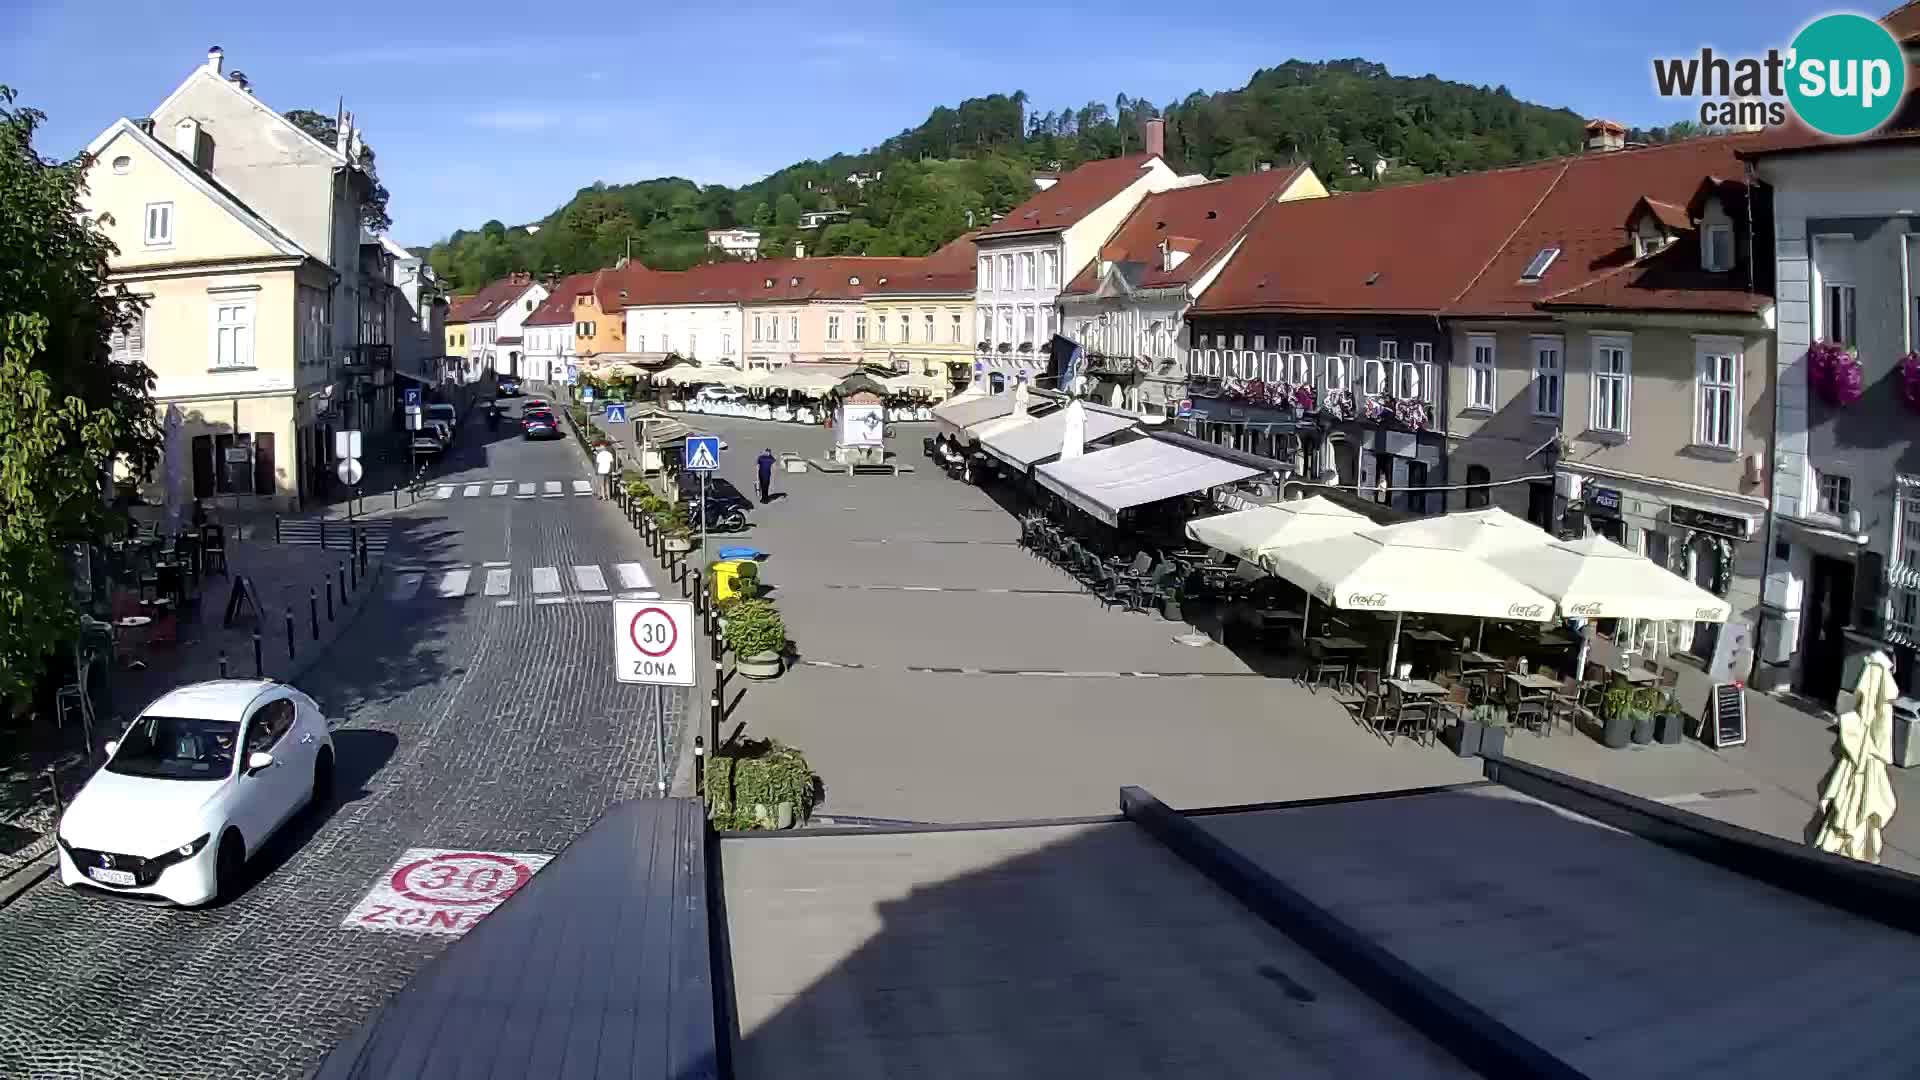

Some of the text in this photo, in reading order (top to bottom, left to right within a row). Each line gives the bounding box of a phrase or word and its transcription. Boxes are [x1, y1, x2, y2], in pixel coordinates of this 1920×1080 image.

[643, 623, 666, 644] 30
[633, 661, 677, 676] ZONA
[419, 866, 503, 893] 30
